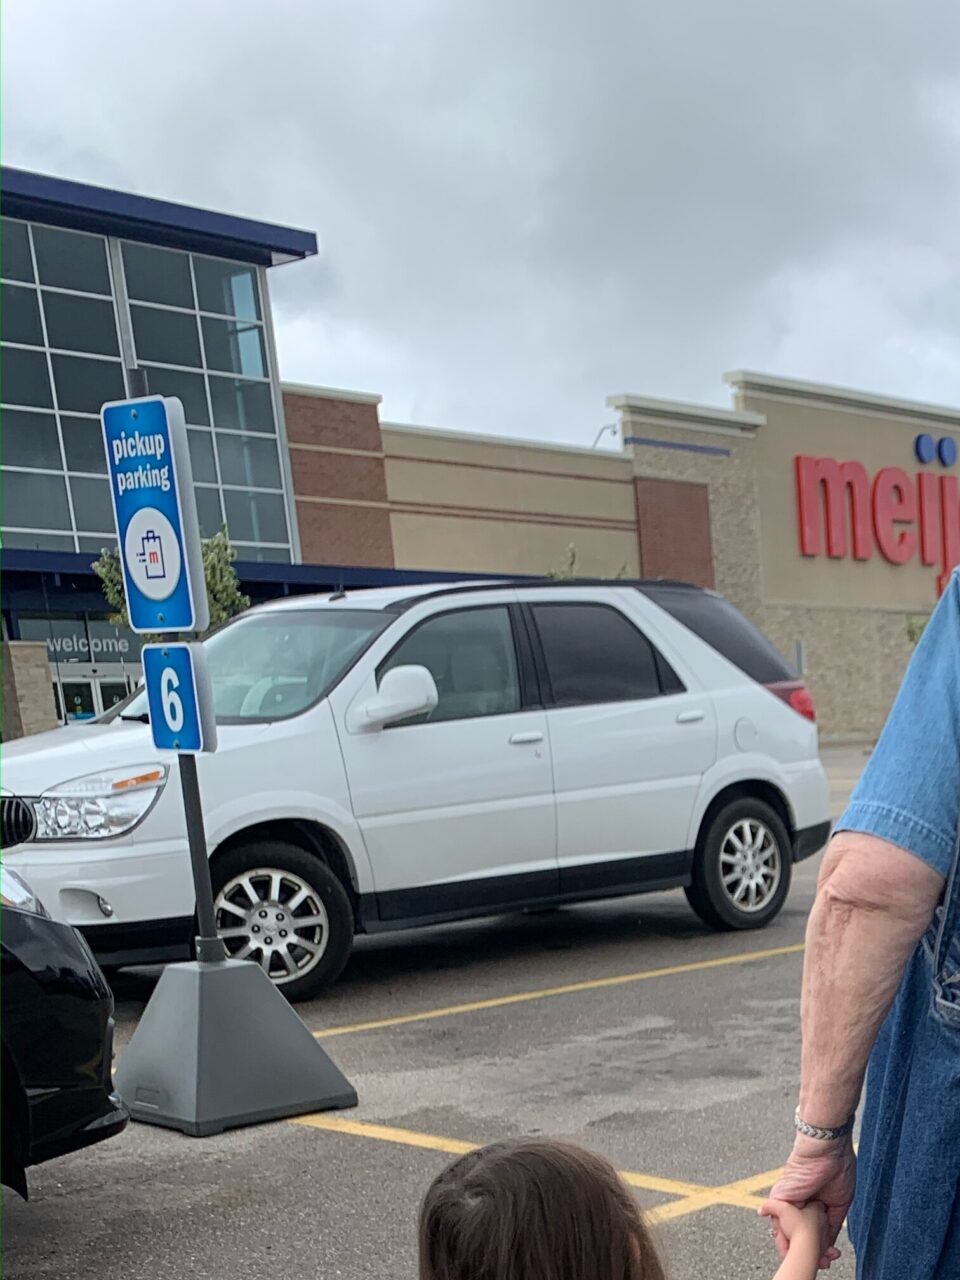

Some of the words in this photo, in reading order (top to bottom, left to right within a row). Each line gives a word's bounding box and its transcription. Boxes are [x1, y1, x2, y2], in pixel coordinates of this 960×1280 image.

[112, 430, 164, 465] pickup
[117, 465, 170, 496] parking
[46, 634, 129, 653] welcome
[160, 667, 184, 733] 6
